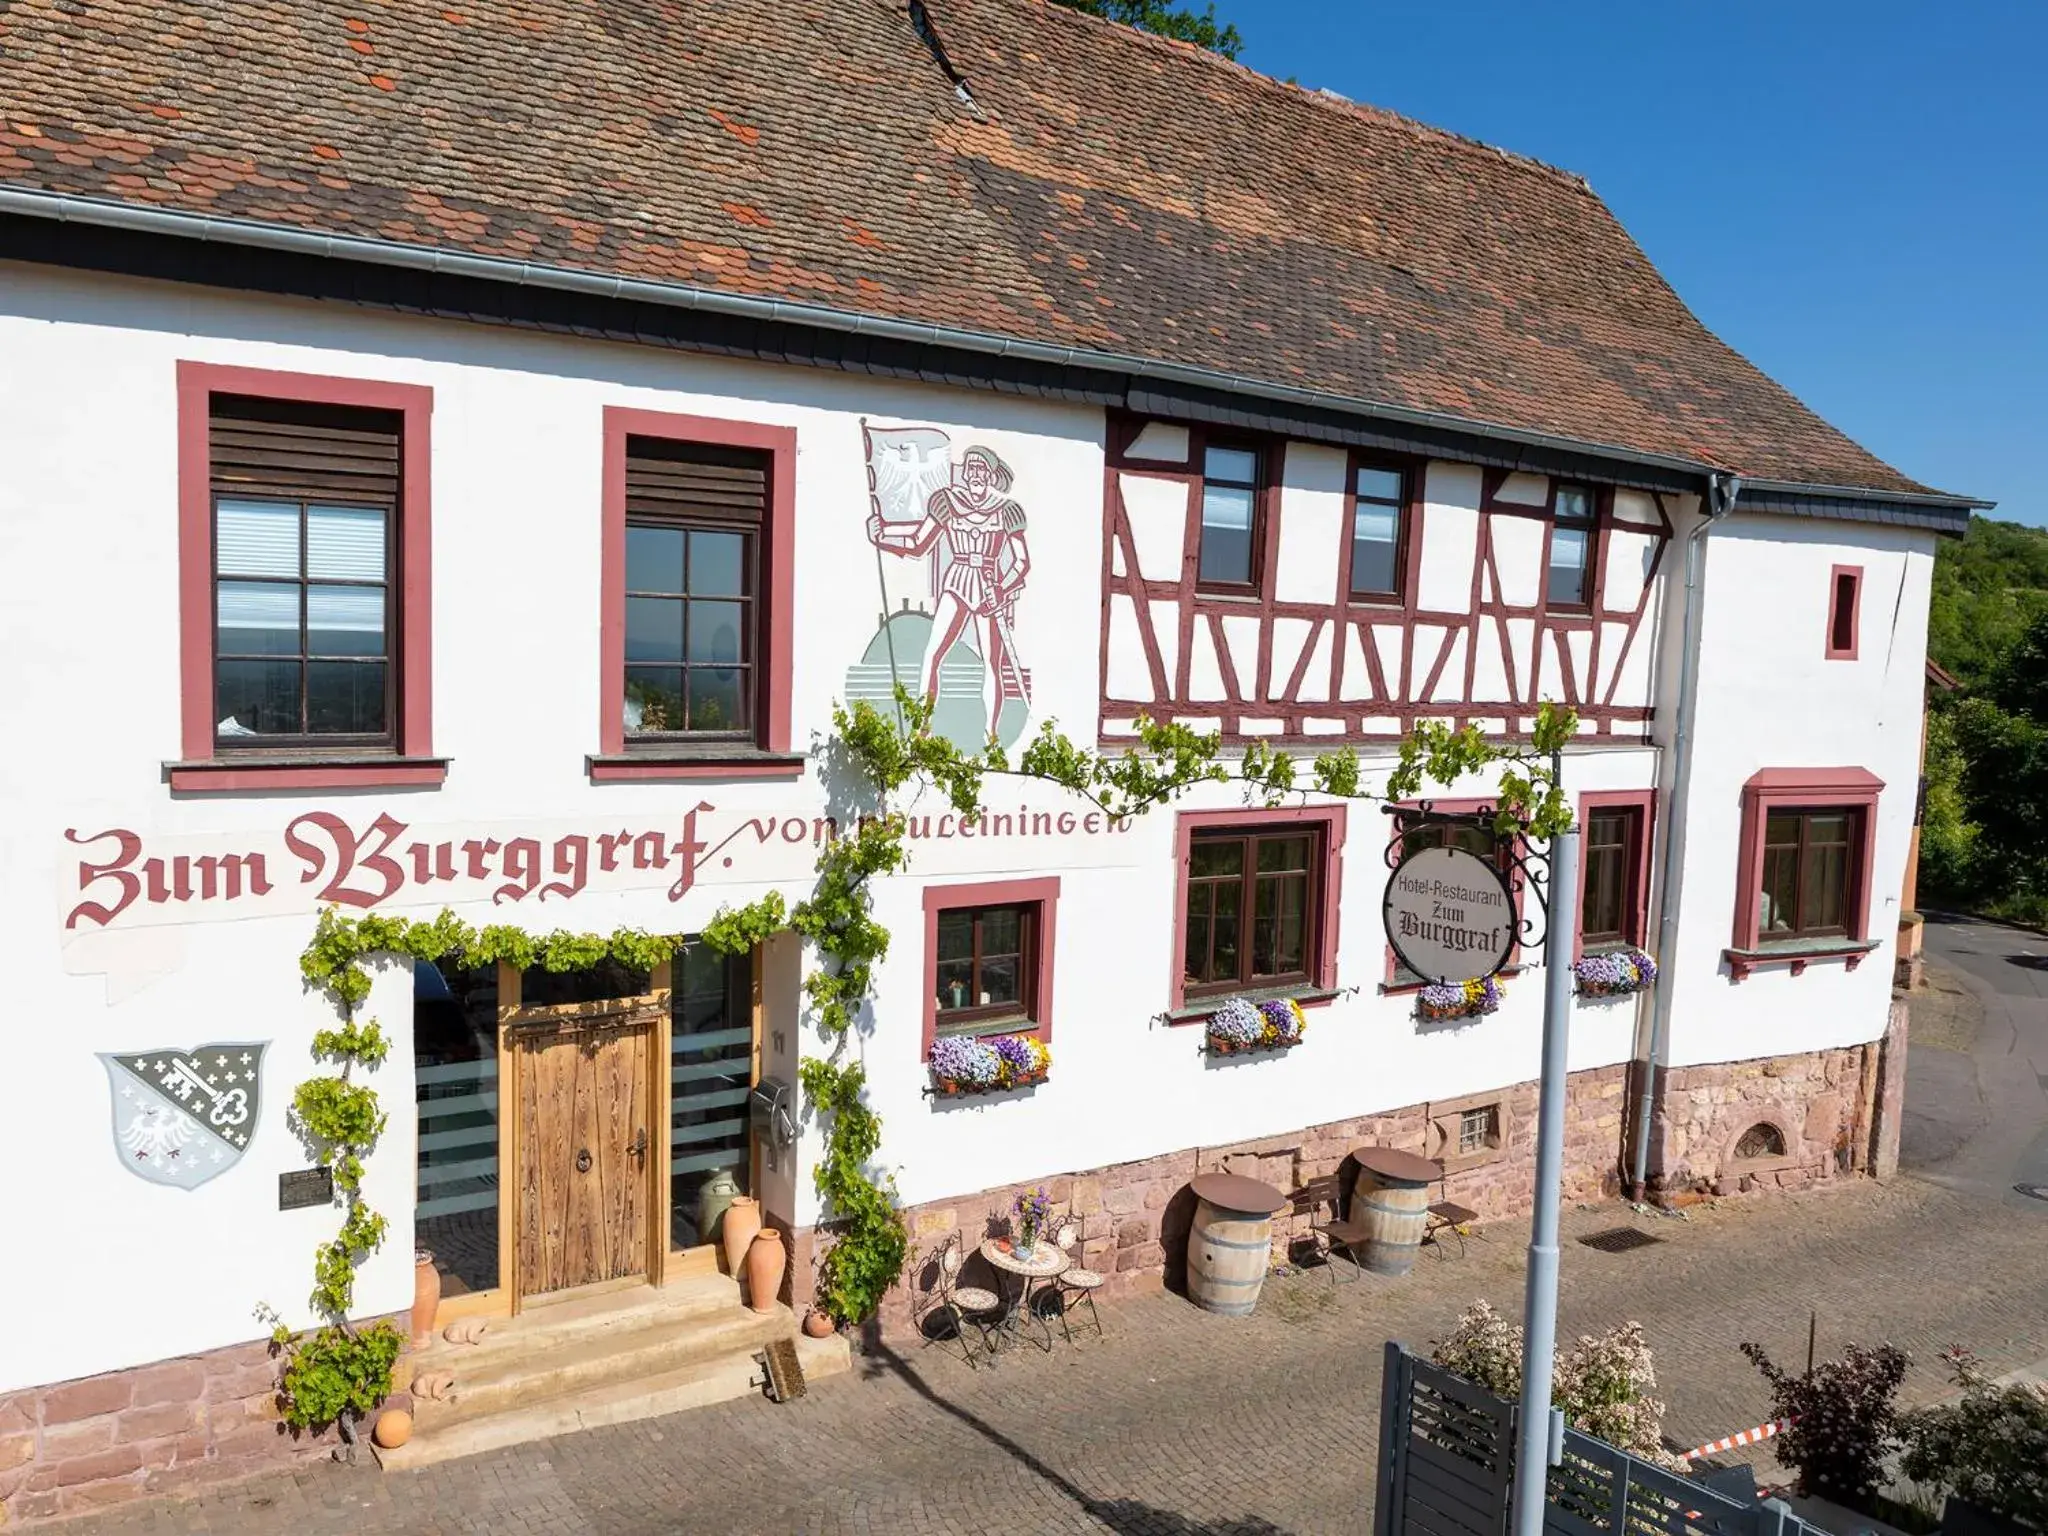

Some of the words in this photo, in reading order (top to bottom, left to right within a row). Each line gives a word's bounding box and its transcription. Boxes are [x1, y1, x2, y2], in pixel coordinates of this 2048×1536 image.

[64, 827, 274, 929] Zum
[748, 815, 839, 844] von
[1398, 875, 1502, 907] Hotel-Restaurant
[1431, 899, 1465, 923] Zum
[1399, 910, 1500, 953] Burggraf
